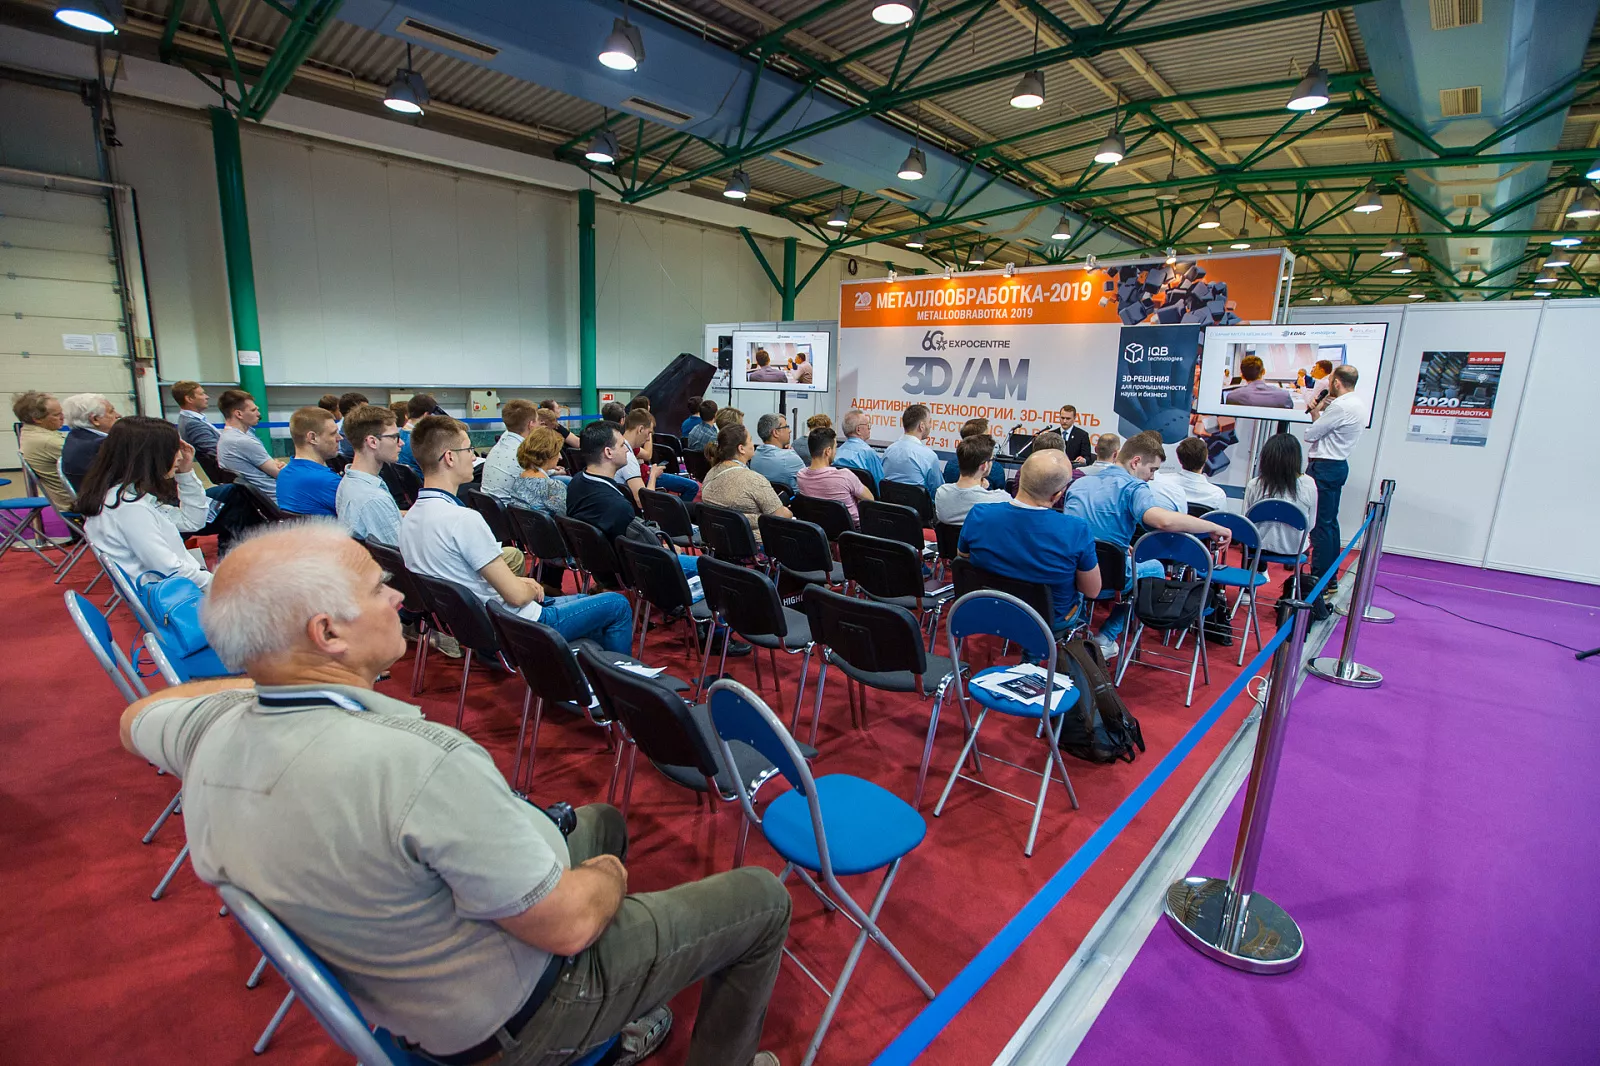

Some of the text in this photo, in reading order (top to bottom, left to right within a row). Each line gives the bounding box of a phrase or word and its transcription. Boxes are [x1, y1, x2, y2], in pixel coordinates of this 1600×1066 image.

[876, 281, 1092, 309] МЕТАЛЛООБРАБОТКА-2019
[917, 307, 1033, 320] METALLOOBRABOTKA 2019
[948, 340, 1010, 349] EXPOCENTRE
[902, 356, 1030, 401] 3D/AM
[1122, 375, 1170, 383] 3D-РЕШЕНИЯ
[1416, 397, 1460, 407] 2020
[851, 398, 927, 412] АДДИТИВН
[930, 402, 1016, 421] ТЕХНОЛОГИИ.
[1020, 409, 1101, 427] 3D-ПЕАТЬ
[1414, 408, 1490, 417] METALLOOBRABOTKA
